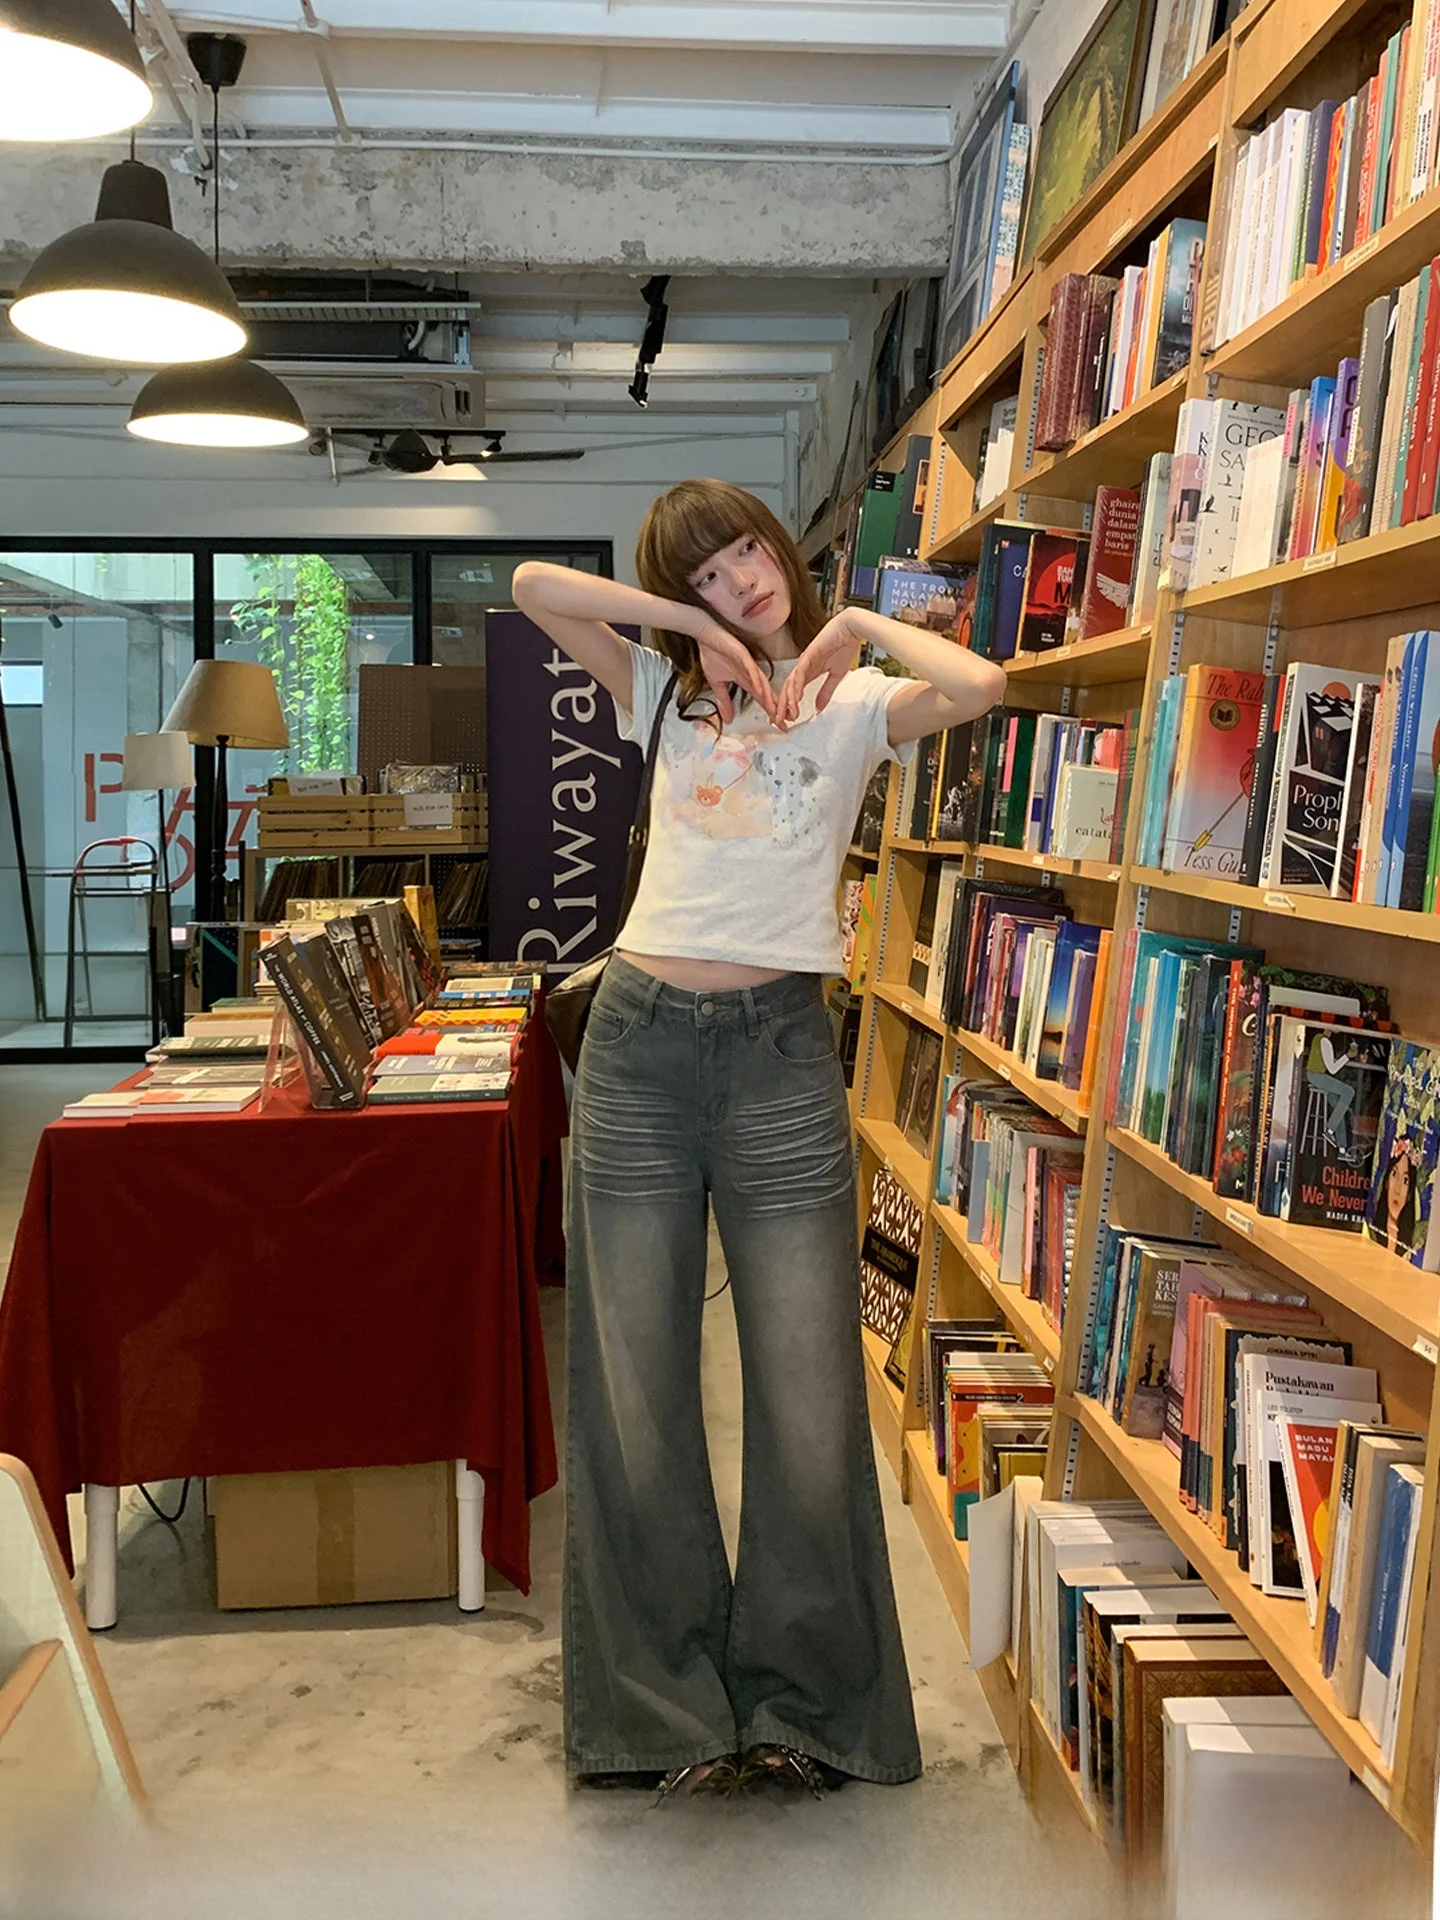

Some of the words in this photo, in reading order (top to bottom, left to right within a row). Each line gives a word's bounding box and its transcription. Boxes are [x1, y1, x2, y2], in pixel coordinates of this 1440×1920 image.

[1403, 375, 1414, 416] CRITICAL
[1398, 418, 1410, 455] ESSAYS
[1108, 509, 1136, 519] dunia
[1104, 538, 1129, 550] baris
[893, 579, 916, 590] THE
[1206, 673, 1233, 698] The
[516, 648, 621, 973] Riwayat
[1302, 807, 1339, 832] Son
[1184, 847, 1214, 871] Tess
[277, 971, 294, 998] WORLD
[289, 994, 303, 1015] ATLAS
[303, 1020, 321, 1046] COFFEE
[1301, 1184, 1325, 1206] We
[1329, 1188, 1368, 1211] Never
[1326, 1210, 1348, 1221] NADIA
[1265, 1347, 1298, 1358] JOHANNA
[1299, 1349, 1318, 1359] SPYRI
[1265, 1371, 1335, 1391] Pustakawan
[1017, 1392, 1024, 1405] 2
[1295, 1433, 1334, 1445] BULAN
[1297, 1443, 1329, 1453] MADU
